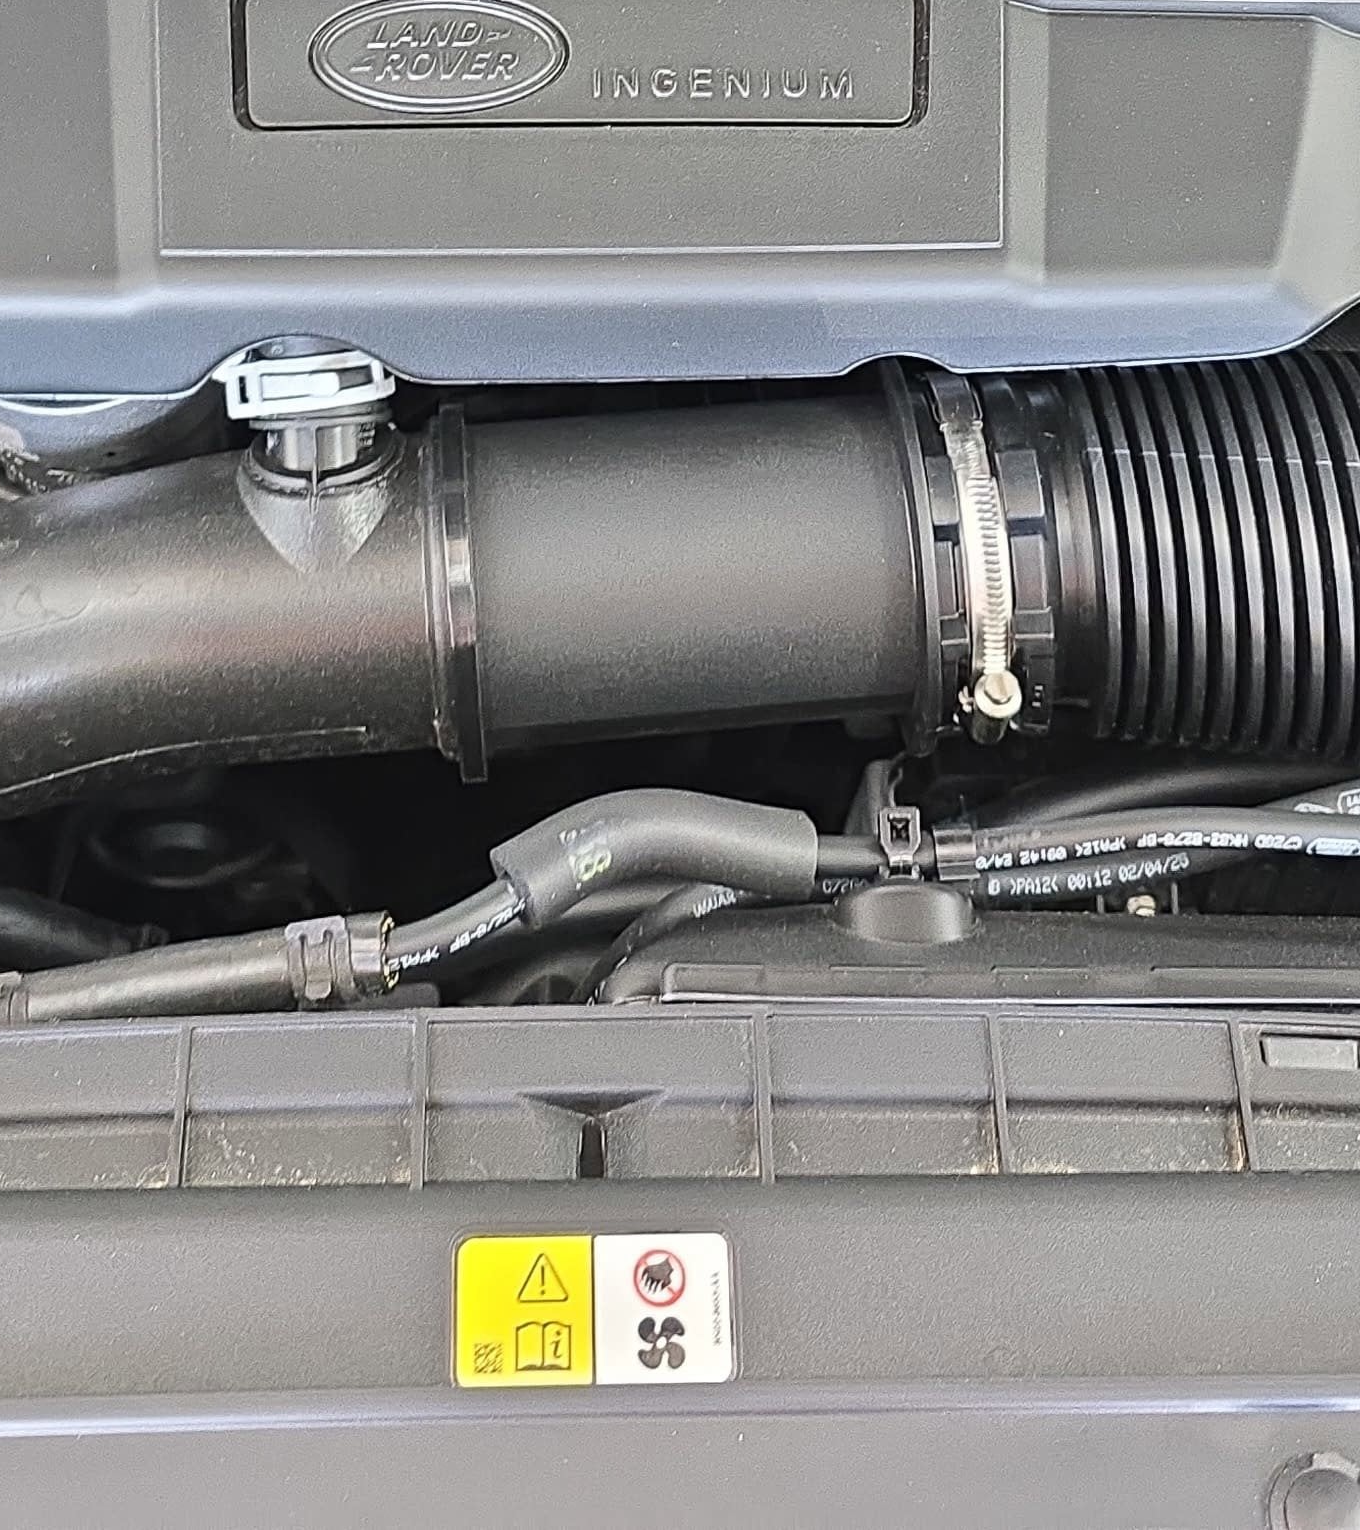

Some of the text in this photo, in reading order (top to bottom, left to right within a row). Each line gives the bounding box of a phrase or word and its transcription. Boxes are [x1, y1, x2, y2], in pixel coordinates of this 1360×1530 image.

[366, 20, 485, 49] LAND
[374, 50, 520, 83] ROVER
[591, 66, 858, 102] INGENIUM
